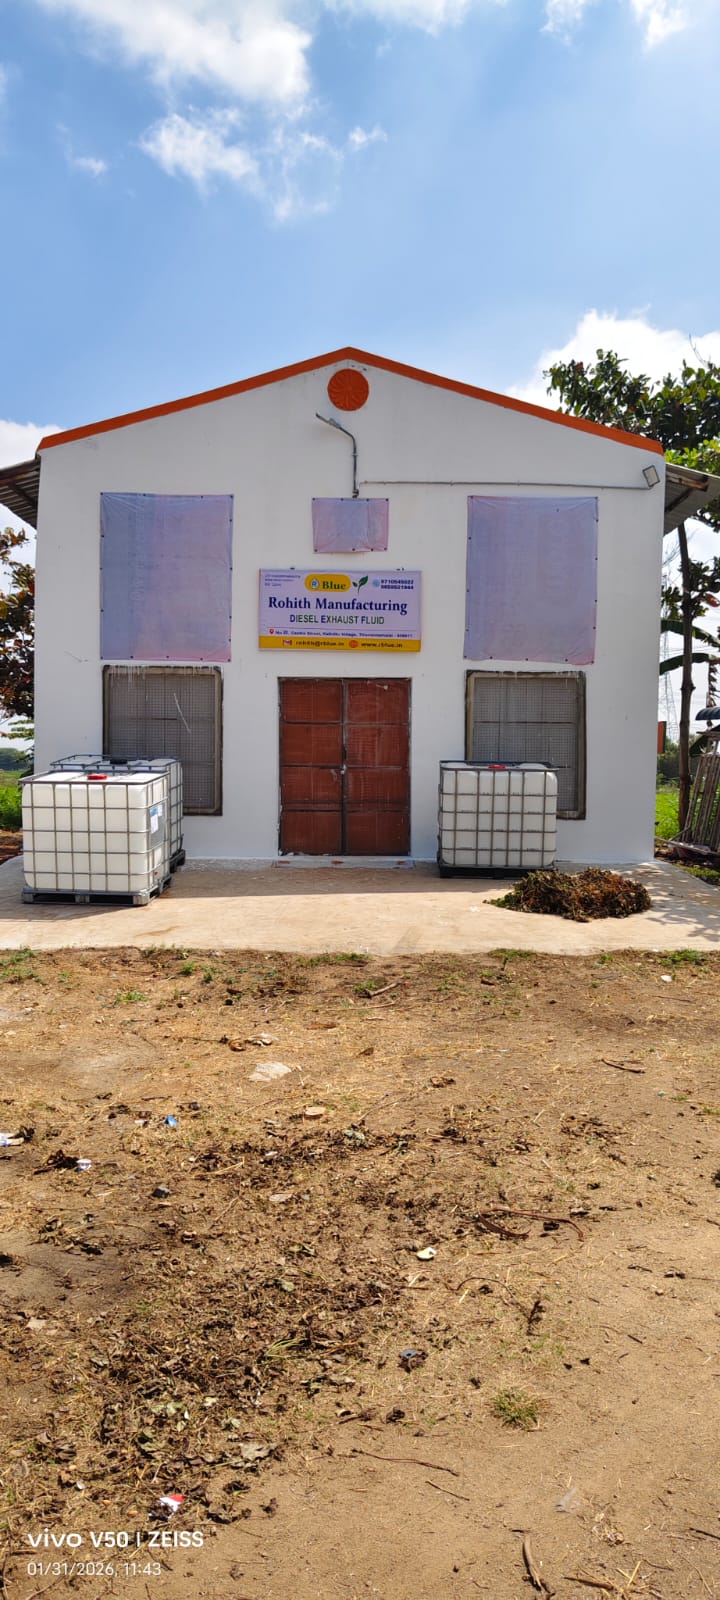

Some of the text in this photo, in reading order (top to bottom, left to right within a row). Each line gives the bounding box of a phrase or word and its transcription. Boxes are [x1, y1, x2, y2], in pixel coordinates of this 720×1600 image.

[322, 580, 347, 590] Blue
[268, 596, 408, 616] Rohith Manufacturing
[289, 614, 385, 625] DIESEL EXHAUST FLUID
